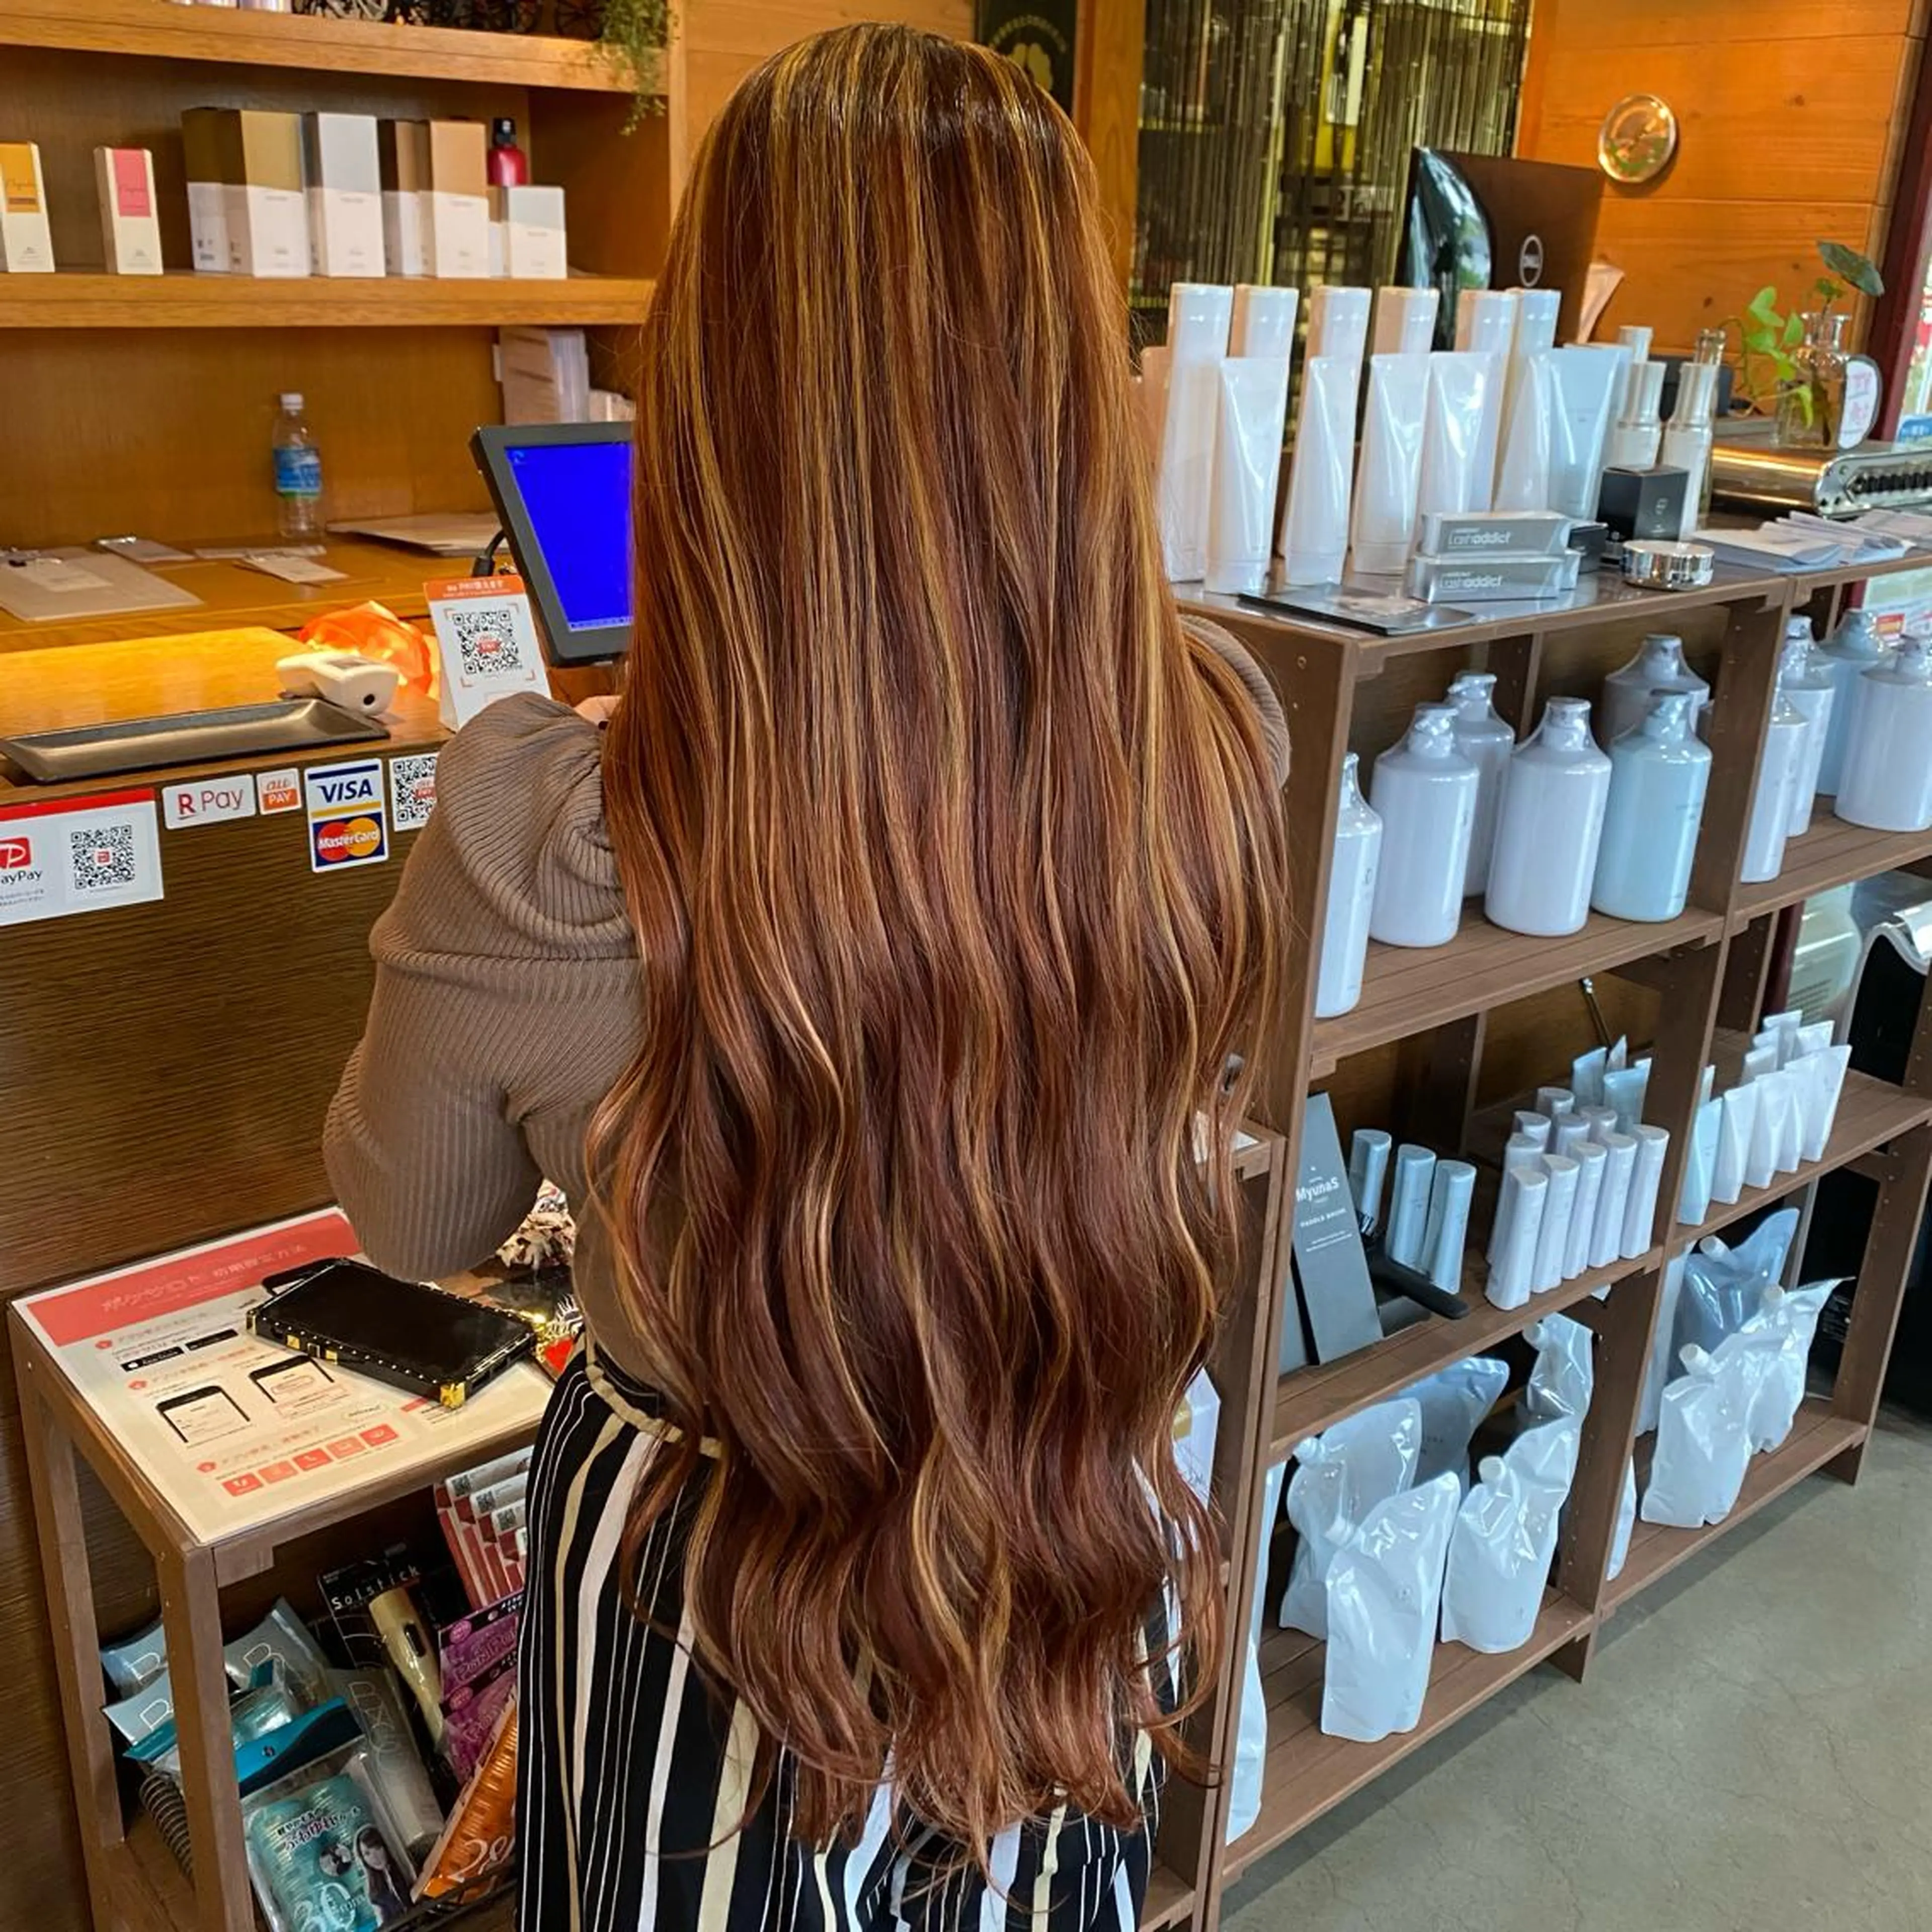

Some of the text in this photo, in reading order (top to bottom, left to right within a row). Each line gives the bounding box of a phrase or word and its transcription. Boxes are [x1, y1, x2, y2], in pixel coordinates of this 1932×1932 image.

[177, 788, 244, 816] R Pay
[268, 790, 292, 805] PAY
[316, 778, 373, 803] VISA
[317, 829, 380, 850] MasterCard
